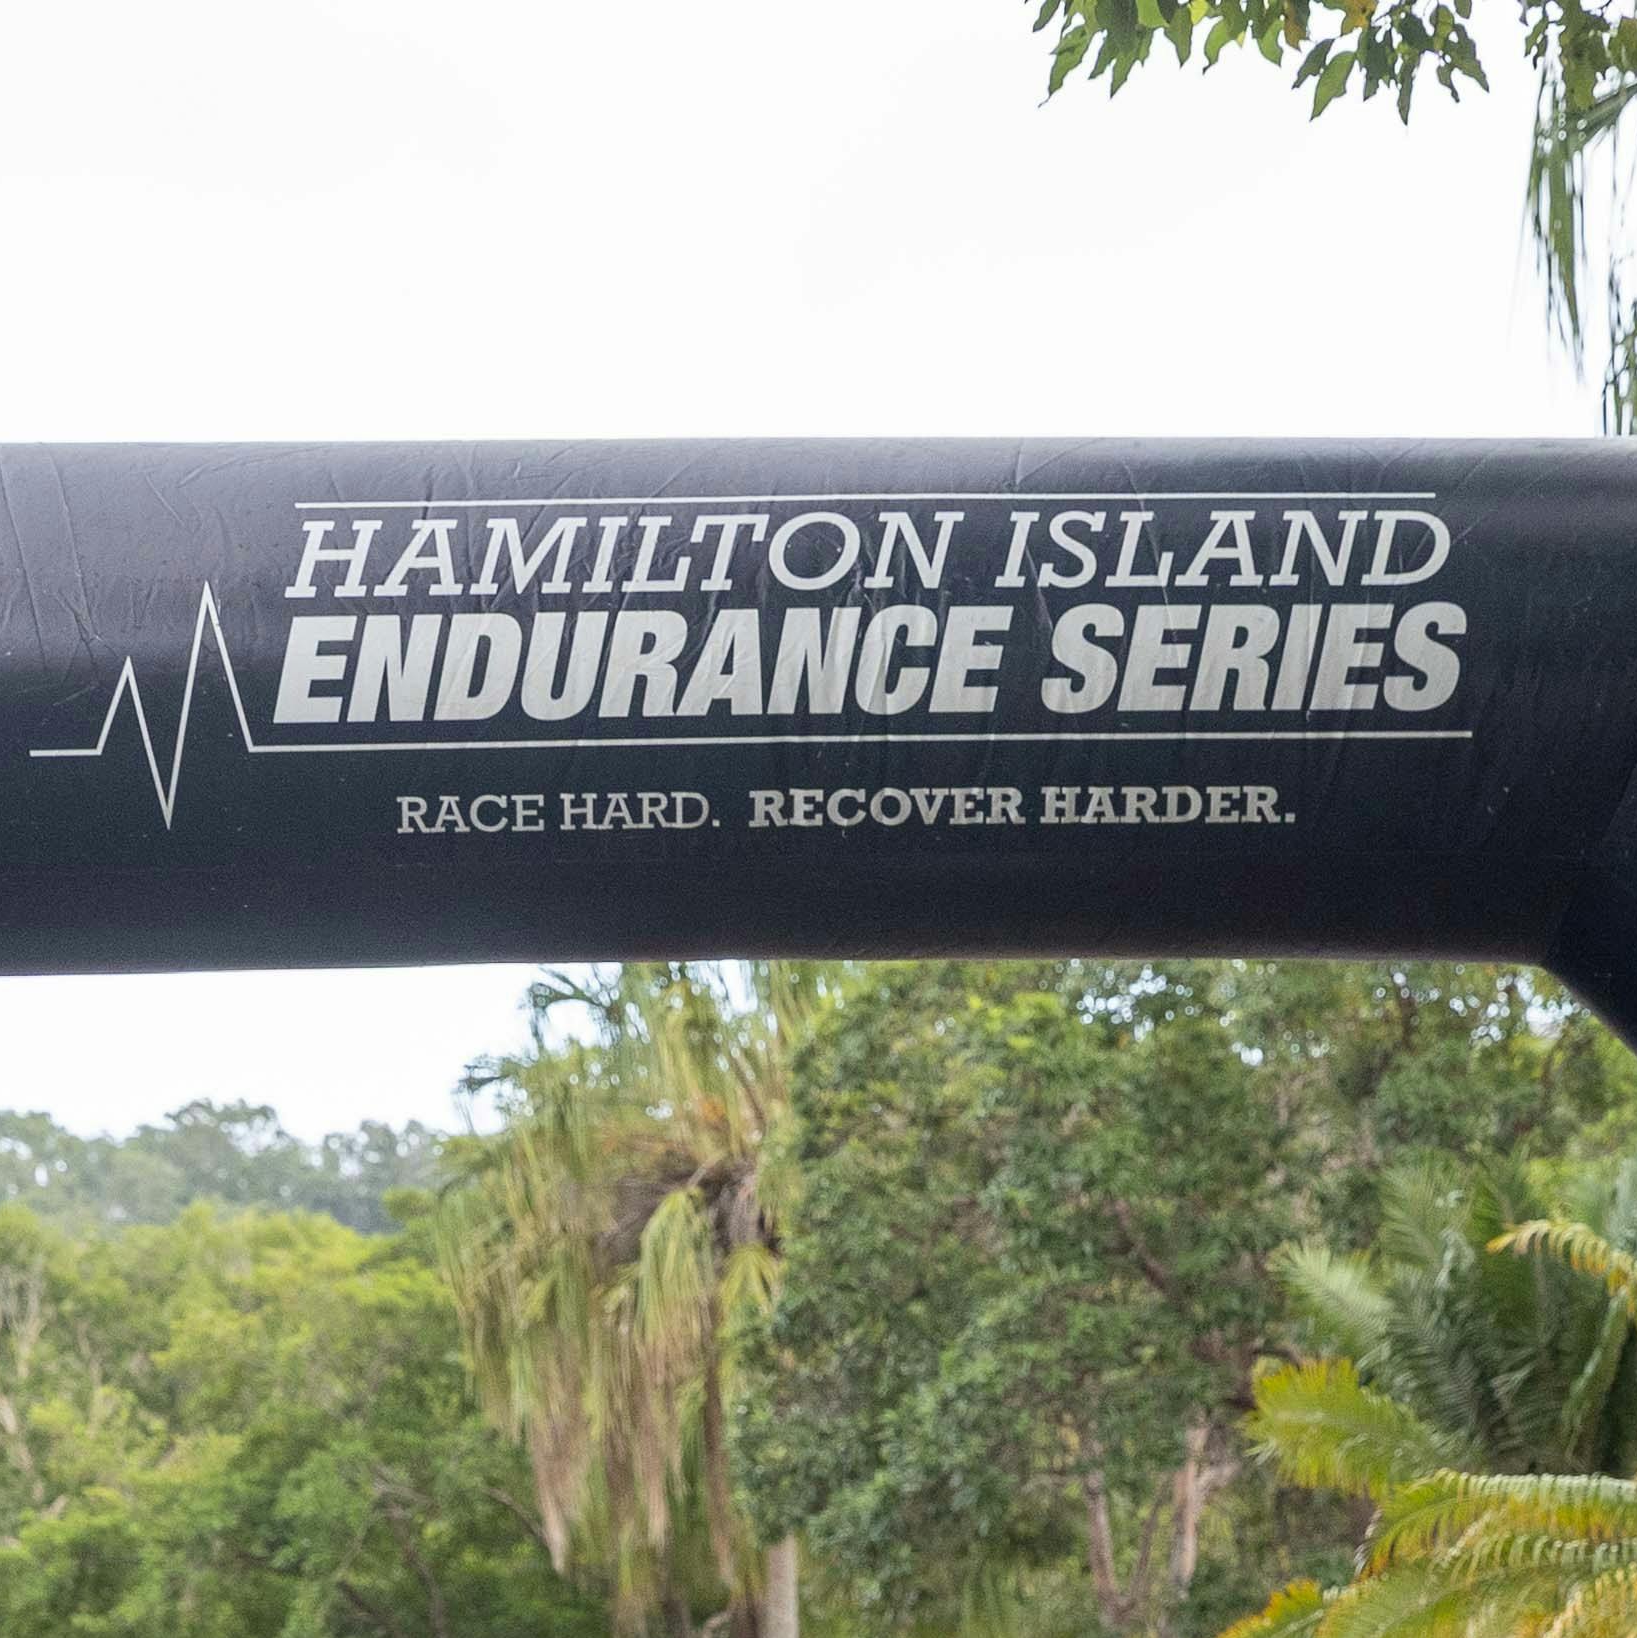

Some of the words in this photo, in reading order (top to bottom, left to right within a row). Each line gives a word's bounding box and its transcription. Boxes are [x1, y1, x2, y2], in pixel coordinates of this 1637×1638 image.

[284, 511, 965, 599] HAMILTON
[994, 510, 1452, 589] ISLAND
[273, 604, 1015, 724] ENDURANCE
[1041, 602, 1468, 714] SERIES
[396, 794, 545, 834] RACE
[559, 791, 723, 831] HARD.
[748, 786, 1027, 829] RECOVER
[1039, 785, 1297, 824] HARDER.
